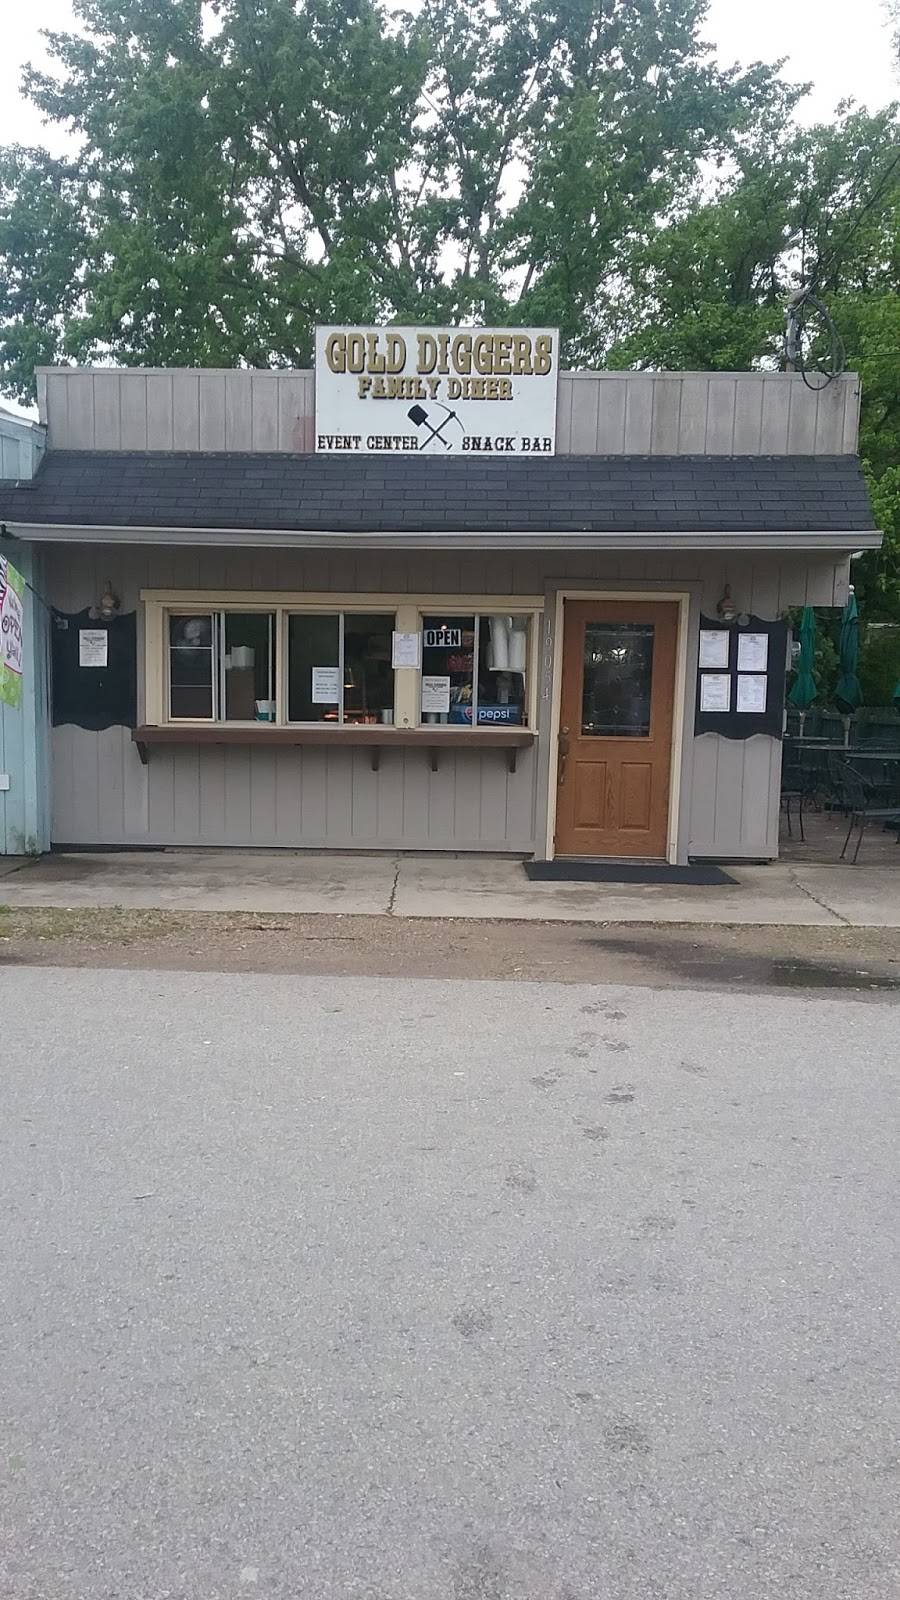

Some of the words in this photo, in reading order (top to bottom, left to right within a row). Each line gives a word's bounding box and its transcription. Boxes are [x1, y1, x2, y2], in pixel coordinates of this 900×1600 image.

[325, 333, 407, 374] GOLD
[416, 334, 553, 376] DIGGERS
[358, 376, 441, 400] FAMILY
[447, 377, 514, 401] DINER
[318, 435, 361, 450] EVENT
[366, 435, 419, 451] CENTER
[462, 436, 517, 452] SNACK
[520, 437, 552, 452] BAR
[427, 631, 459, 646] OPEN
[479, 709, 510, 720] pepsi
